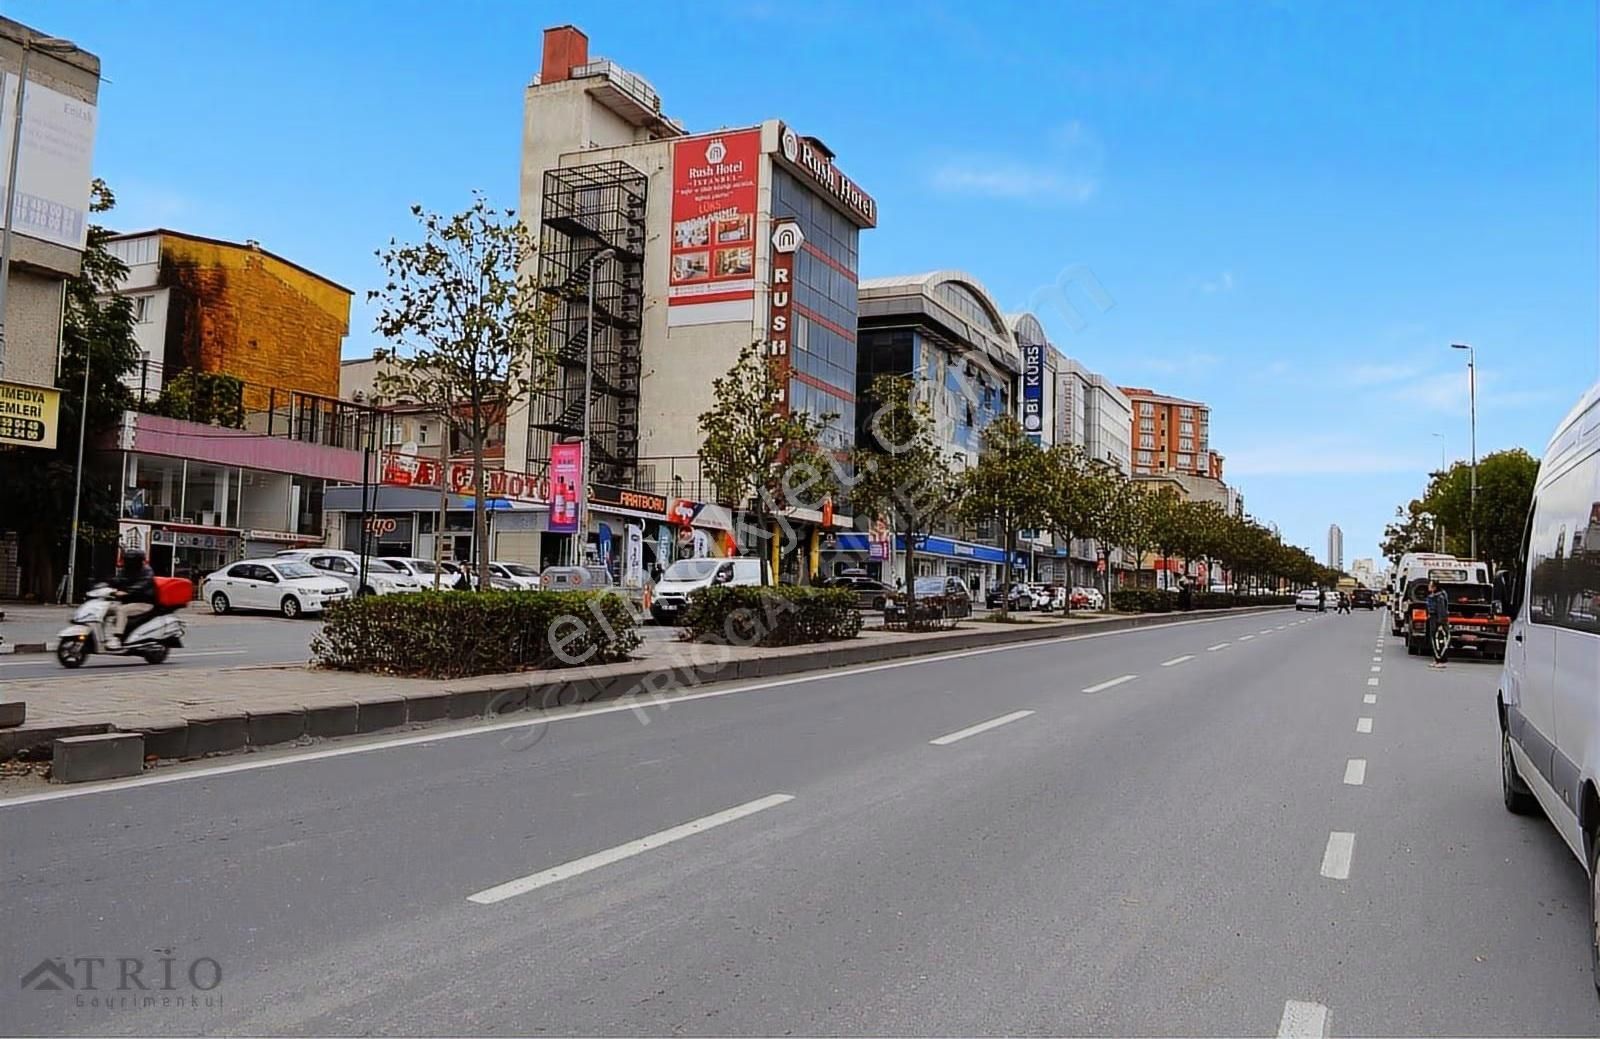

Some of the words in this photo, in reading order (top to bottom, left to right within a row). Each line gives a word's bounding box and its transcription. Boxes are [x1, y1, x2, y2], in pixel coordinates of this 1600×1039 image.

[689, 165, 714, 179] Rush
[716, 160, 743, 175] Hotel
[801, 143, 834, 187] Rush
[841, 175, 873, 218] Hotel
[771, 268, 789, 355] RUSH
[1026, 345, 1039, 387] KURS
[490, 472, 551, 500] MOTO
